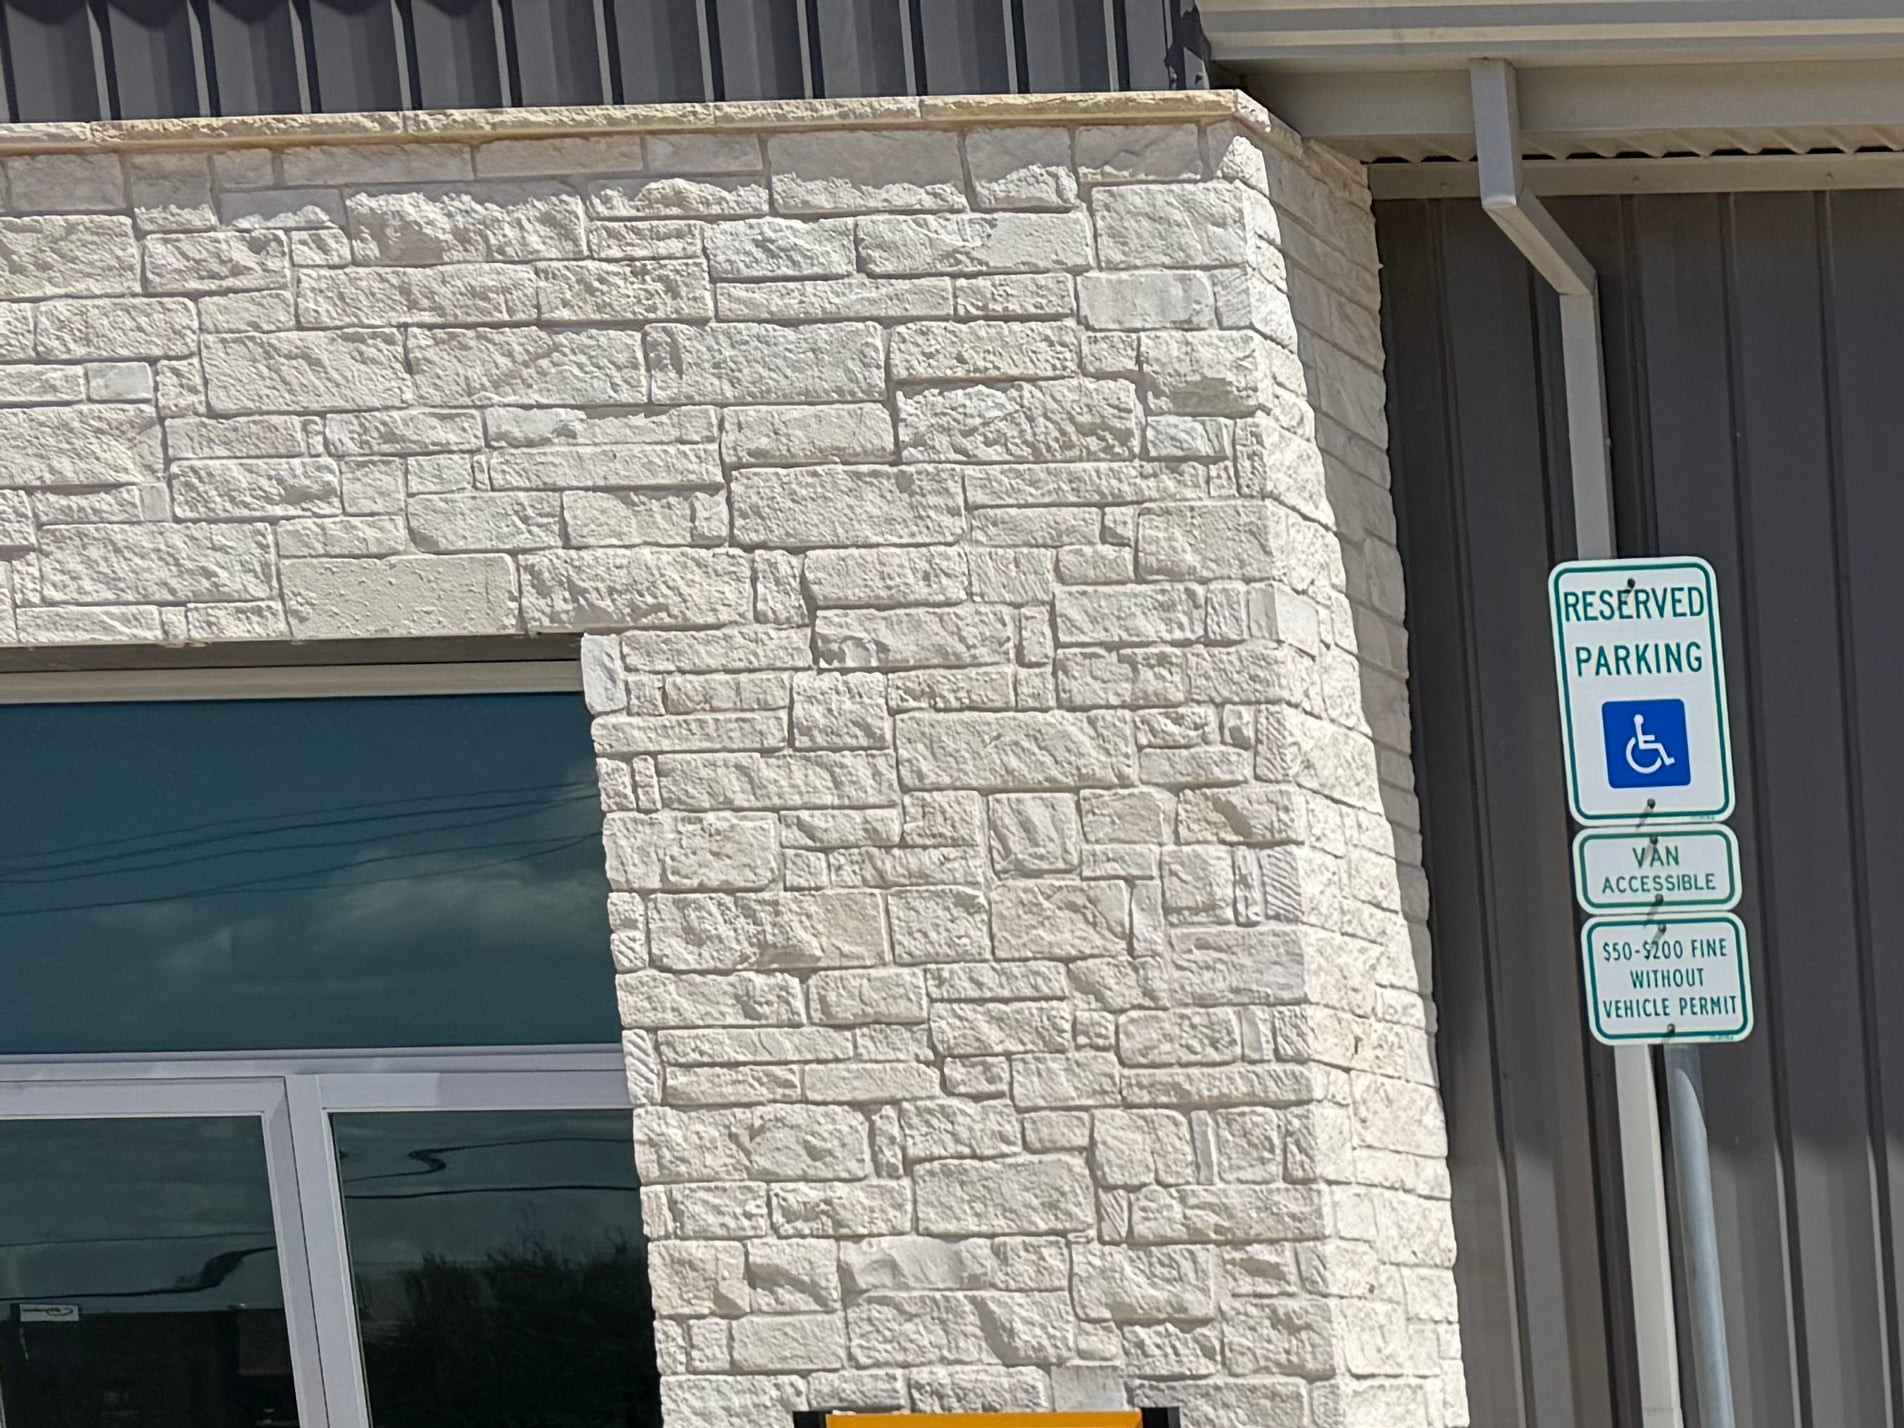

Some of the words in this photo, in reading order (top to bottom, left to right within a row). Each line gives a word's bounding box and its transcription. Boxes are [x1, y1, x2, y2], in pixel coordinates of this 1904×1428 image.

[1564, 586, 1705, 622] RESERVED
[1576, 641, 1703, 677] PARKING
[1632, 845, 1680, 868] VAN
[1602, 873, 1717, 894] ACCESSIBLE
[1602, 939, 1684, 962] $50-$200
[1691, 938, 1728, 958] FINE
[1630, 968, 1705, 989] WITHOUT
[1603, 998, 1670, 1019] VEHICLE
[1679, 995, 1737, 1016] PERMIT
